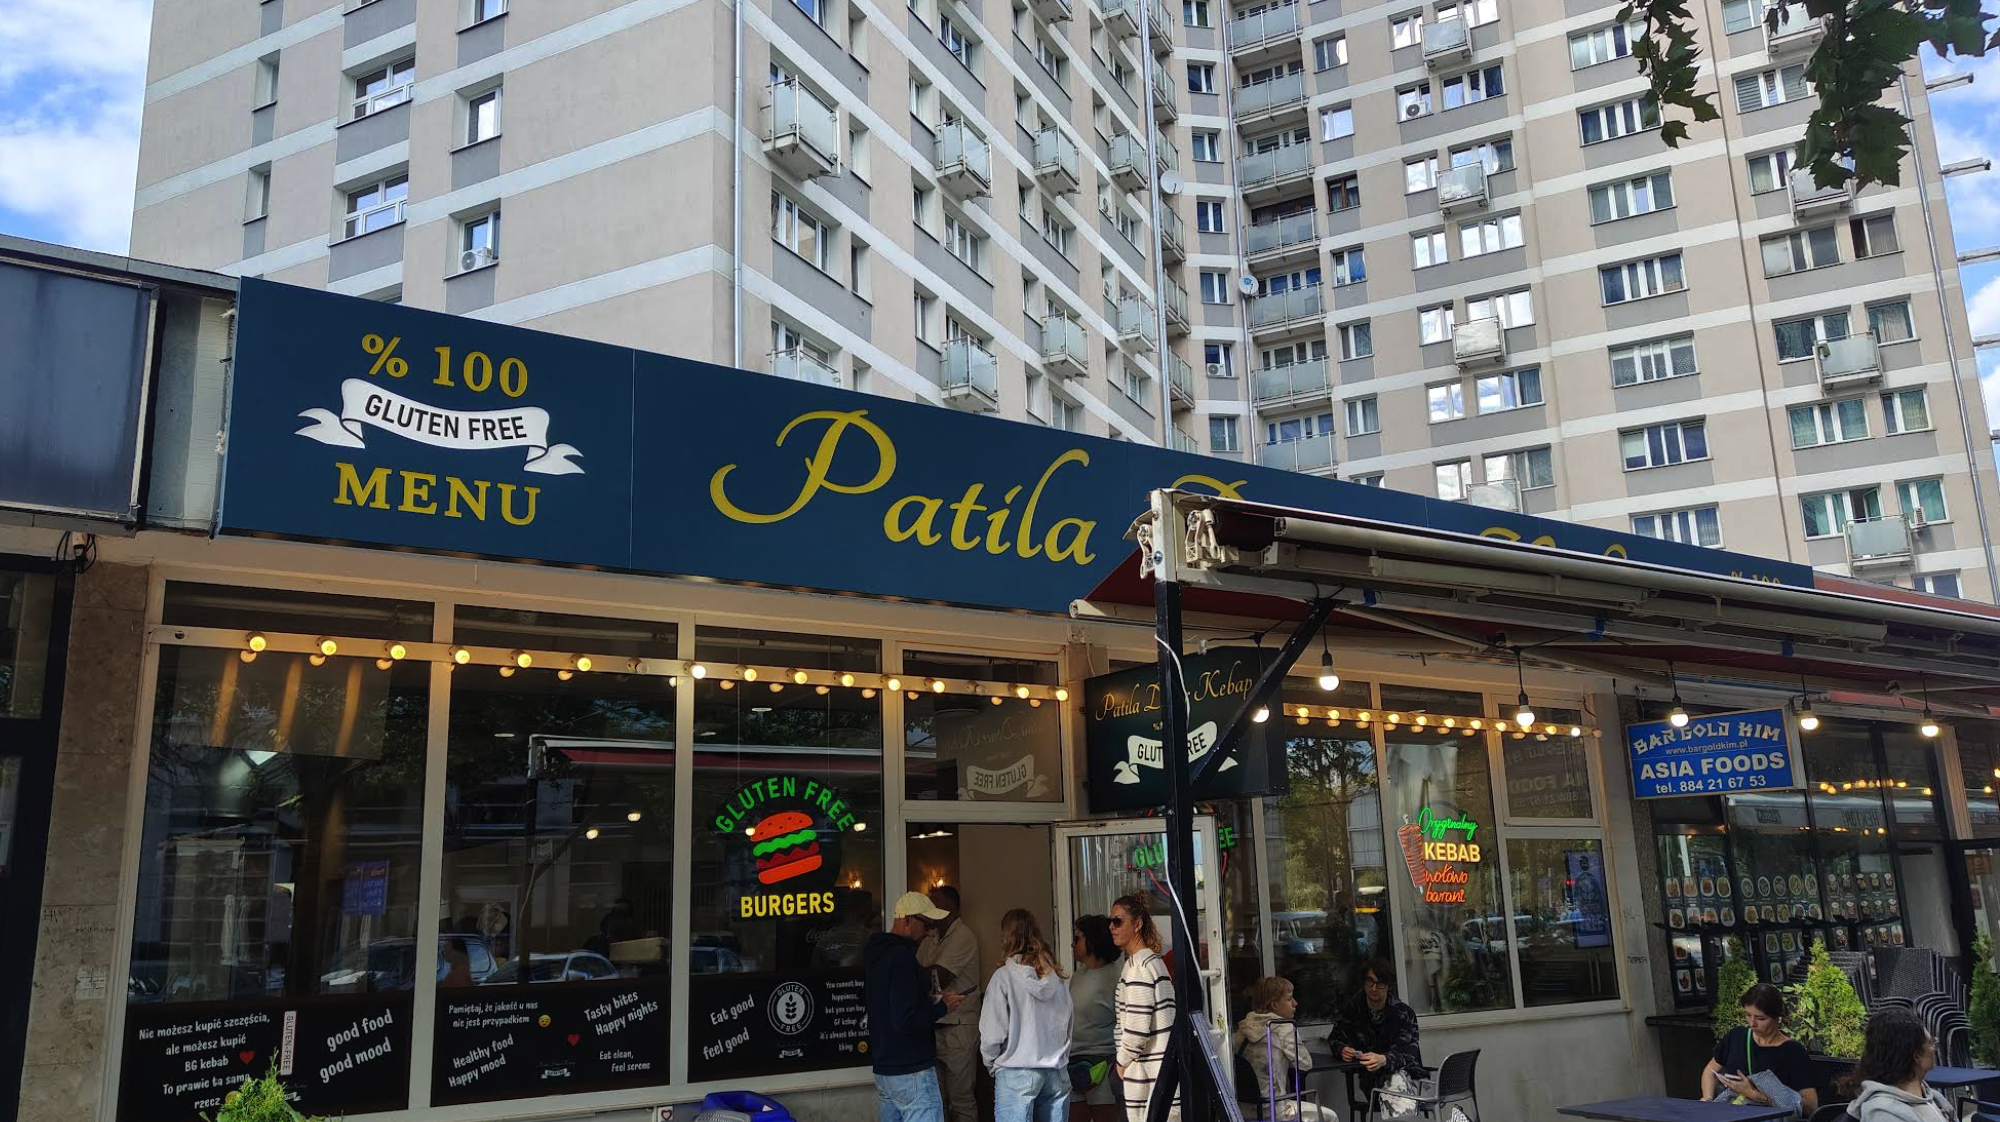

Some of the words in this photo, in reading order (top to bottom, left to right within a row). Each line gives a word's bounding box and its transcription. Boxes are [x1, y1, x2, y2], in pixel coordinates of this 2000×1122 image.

[361, 332, 409, 379] %
[432, 345, 528, 399] 100
[364, 394, 459, 439] GLUTEN
[468, 415, 527, 441] FREE
[332, 461, 541, 527] MENU
[709, 409, 1097, 566] Patila
[1193, 660, 1253, 702] Kebap
[1095, 683, 1140, 721] Patila
[1137, 743, 1163, 762] GLUT
[1187, 732, 1207, 756] REE
[1633, 729, 1677, 755] BAR
[1681, 721, 1730, 741] GOLD
[1737, 721, 1781, 742] KIM
[1665, 740, 1748, 755] www.bargoldkim.pl
[1640, 760, 1695, 780] ASIA
[1700, 752, 1785, 775] FOODS
[1655, 783, 1676, 794] tel.
[1679, 780, 1704, 792] 884
[1707, 778, 1722, 791] 21
[1728, 777, 1743, 789] 67
[1750, 775, 1766, 787] 53
[715, 776, 795, 833] GLUTEN
[804, 781, 856, 832] FREE
[1134, 842, 1164, 869] GLU
[1218, 826, 1236, 849] EE
[1424, 842, 1481, 862] KEBAB
[740, 892, 835, 918] BURGERS
[519, 1002, 524, 1010] u
[525, 1001, 539, 1009] nas
[777, 984, 805, 997] GLUTEN
[452, 1018, 464, 1028] nie
[465, 1017, 481, 1029] jest
[482, 1014, 530, 1029] przypadkiem
[583, 1003, 612, 1022] Tasty
[612, 991, 639, 1010] bites
[595, 1015, 627, 1036] Happy
[627, 1000, 659, 1022] nights
[710, 1007, 729, 1026] Eat
[730, 993, 755, 1020] good
[138, 1028, 155, 1041] Nie
[157, 1024, 193, 1038] możesz
[195, 1018, 222, 1034] kupić
[326, 1021, 360, 1053] good
[362, 1008, 394, 1034] food
[780, 1023, 803, 1032] FREE
[165, 1043, 180, 1056] ale
[182, 1038, 218, 1052] możesz
[220, 1033, 247, 1048] kupić
[452, 1047, 491, 1069] Healthy
[491, 1032, 514, 1053] food
[599, 1050, 612, 1060] Eat
[702, 1038, 724, 1061] feel
[725, 1026, 750, 1054] good
[200, 1054, 229, 1070] kebab
[319, 1052, 353, 1084] good
[355, 1036, 392, 1065] mood
[448, 1068, 479, 1088] Happy
[480, 1053, 507, 1074] mood
[611, 1062, 626, 1073] Feel
[162, 1084, 174, 1096] To
[176, 1077, 210, 1097] prawie
[212, 1075, 223, 1087] ta
[194, 1097, 221, 1110] rzecz
